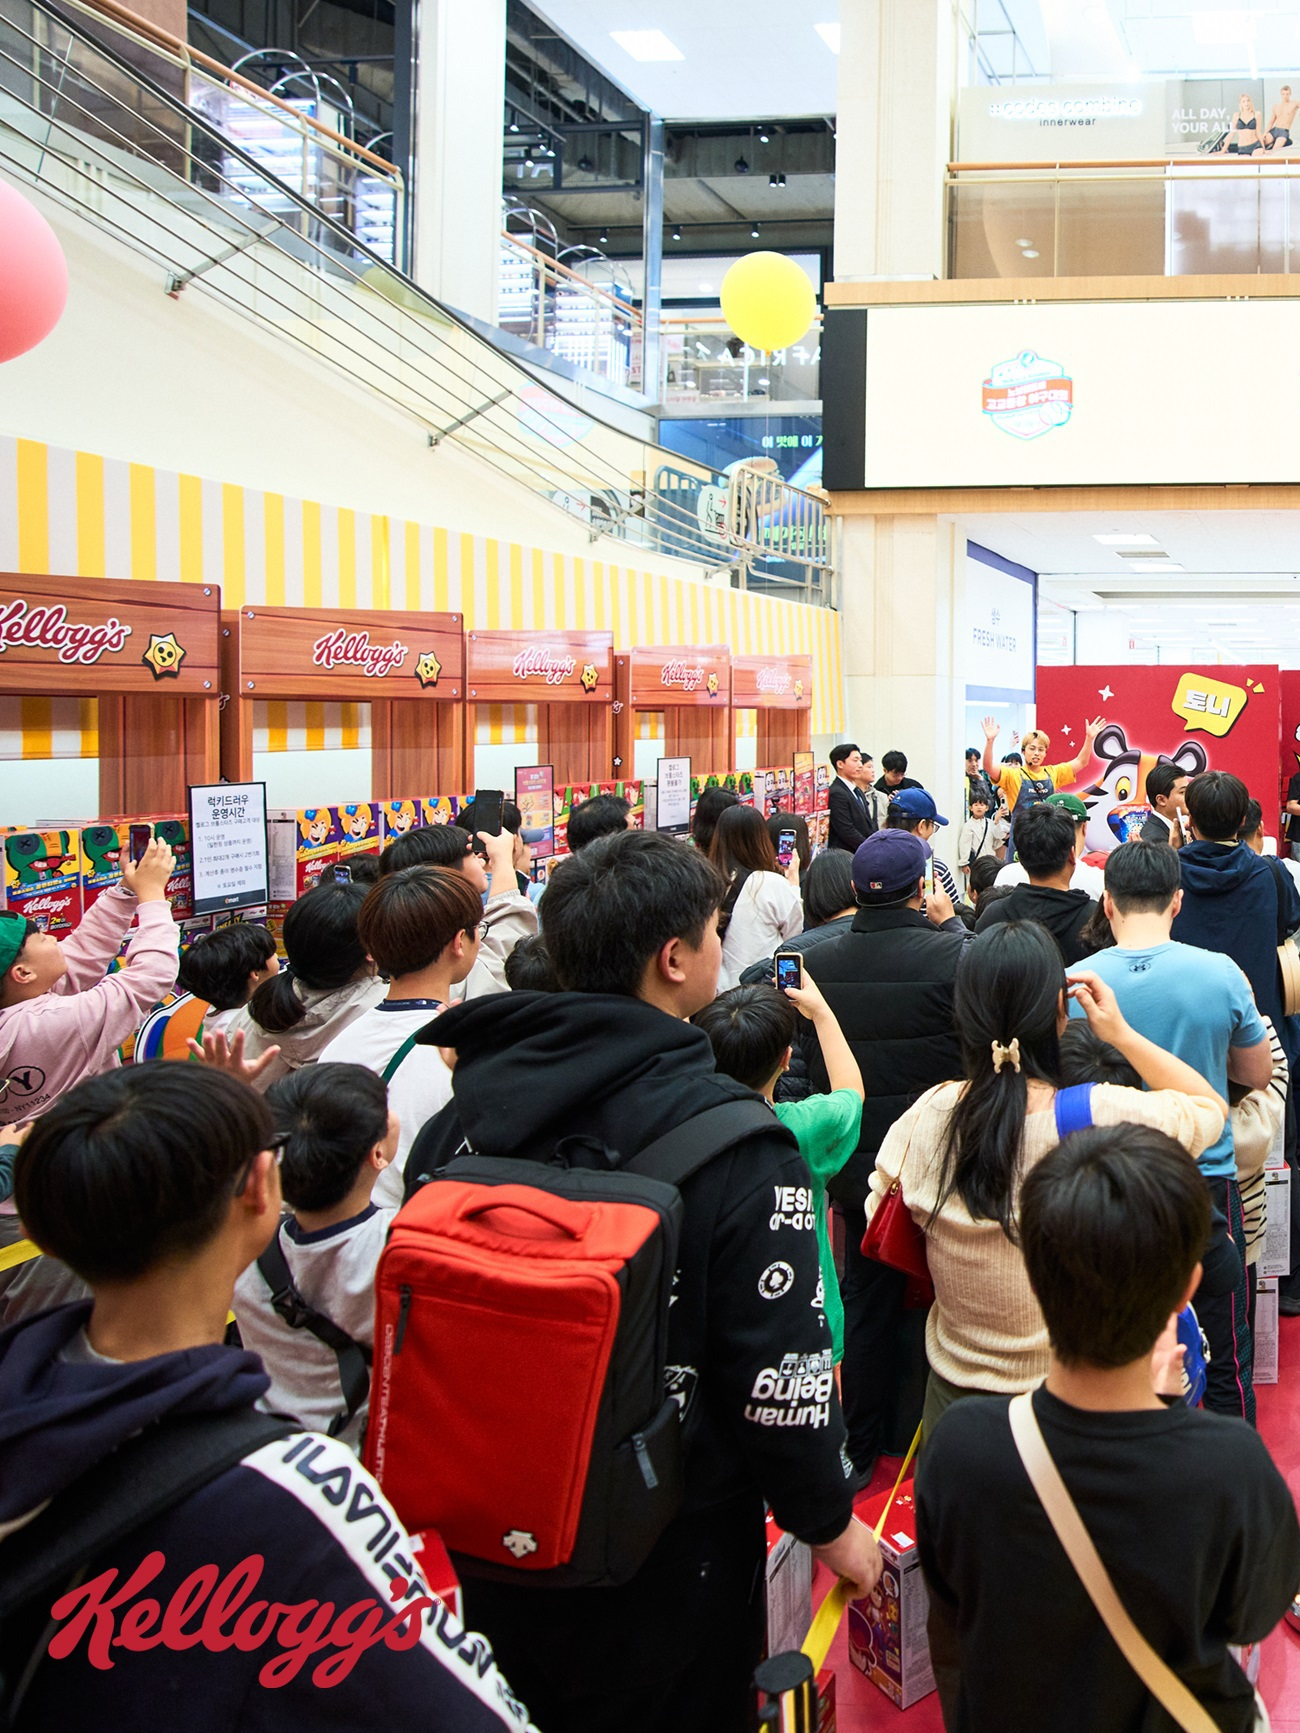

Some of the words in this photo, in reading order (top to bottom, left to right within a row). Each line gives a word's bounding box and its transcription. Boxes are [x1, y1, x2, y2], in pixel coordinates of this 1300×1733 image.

[1039, 117, 1096, 127] innerwear
[1172, 108, 1197, 120] ALL
[1200, 107, 1231, 121] DAY,
[1171, 122, 1209, 134] YOUR
[762, 436, 774, 448] 이
[776, 435, 799, 448] 맛에
[801, 435, 812, 448] 이
[314, 629, 406, 676] Kellogg's
[513, 647, 575, 684] Kellogg's
[661, 659, 704, 690] Kellogg's
[1183, 689, 1231, 717] 토니
[207, 794, 249, 807] 럭키드러우
[212, 807, 245, 820] 운영시간
[23, 896, 72, 914] Kellogg's
[751, 1367, 834, 1403] Being
[744, 1402, 830, 1429] Human
